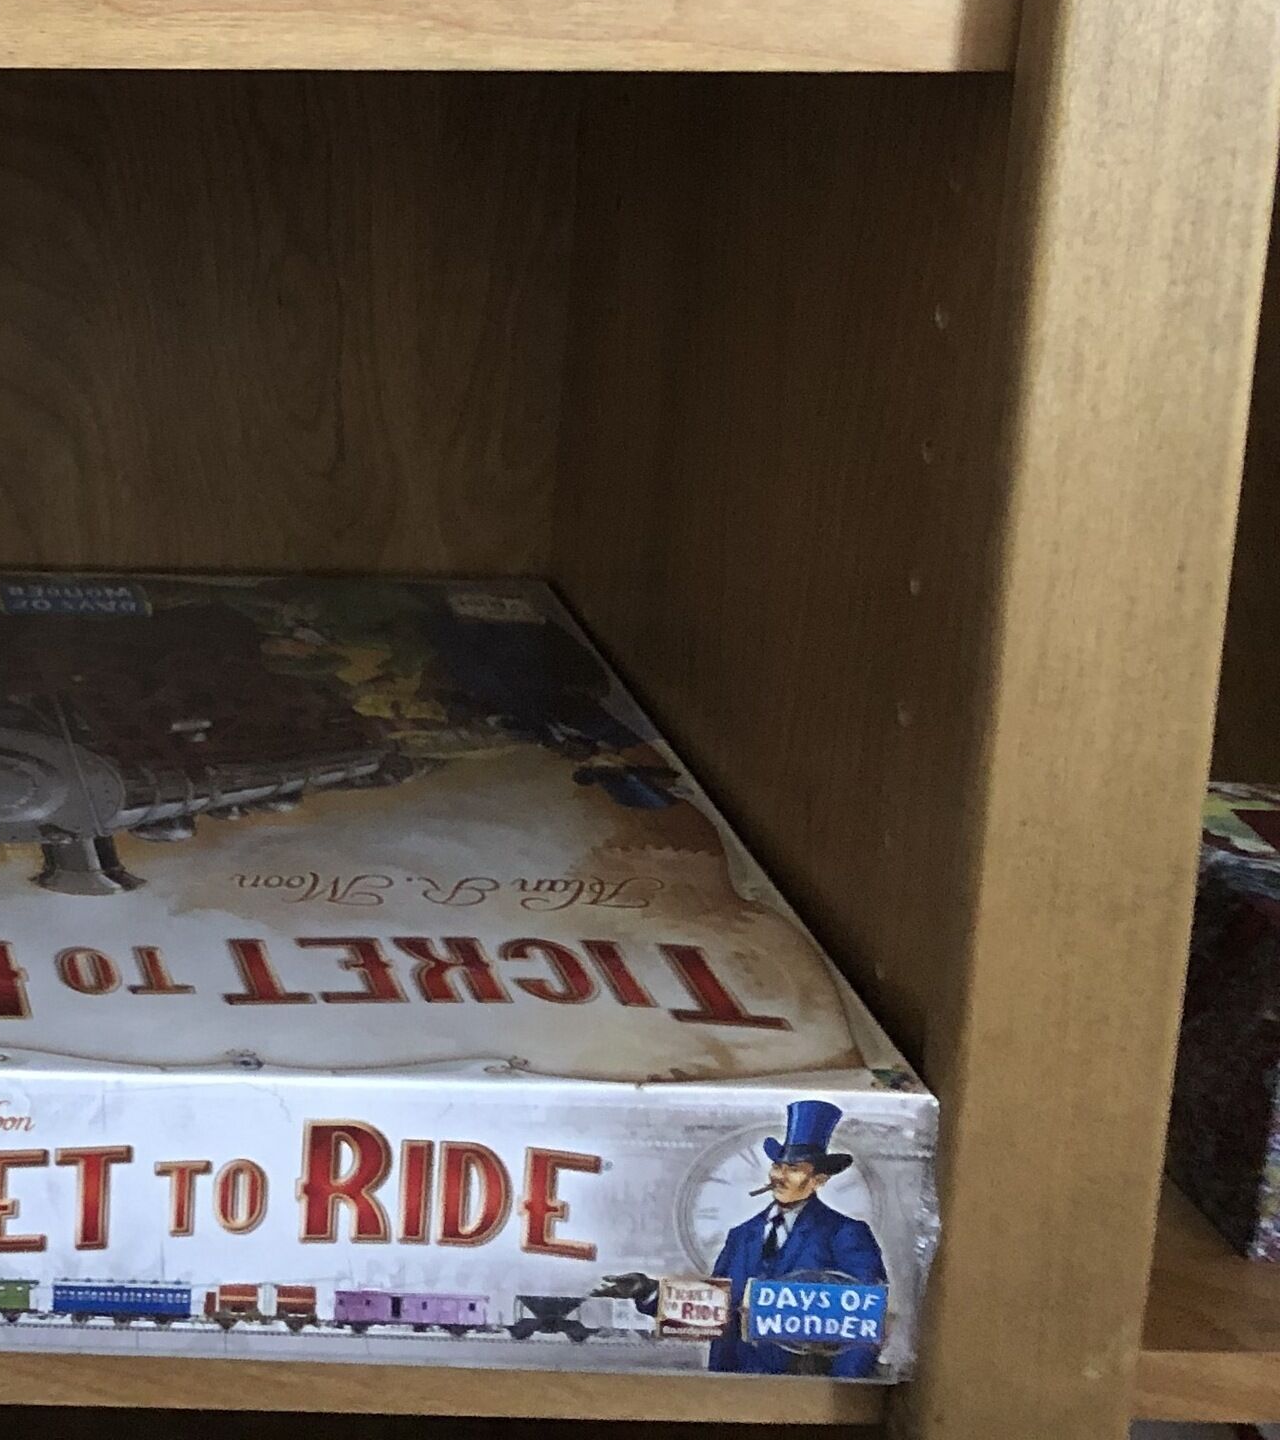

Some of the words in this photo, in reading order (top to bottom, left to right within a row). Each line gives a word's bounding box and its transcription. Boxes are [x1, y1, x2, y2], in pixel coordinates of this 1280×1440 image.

[230, 872, 394, 907] Moon
[512, 875, 666, 912] Alan
[58, 945, 194, 997] TO
[222, 935, 793, 1032] TICKET
[154, 1157, 268, 1237] TO
[297, 1117, 602, 1262] RIDE
[681, 1302, 725, 1322] RIDE
[757, 1286, 831, 1309] DAYS
[840, 1289, 881, 1312] OF
